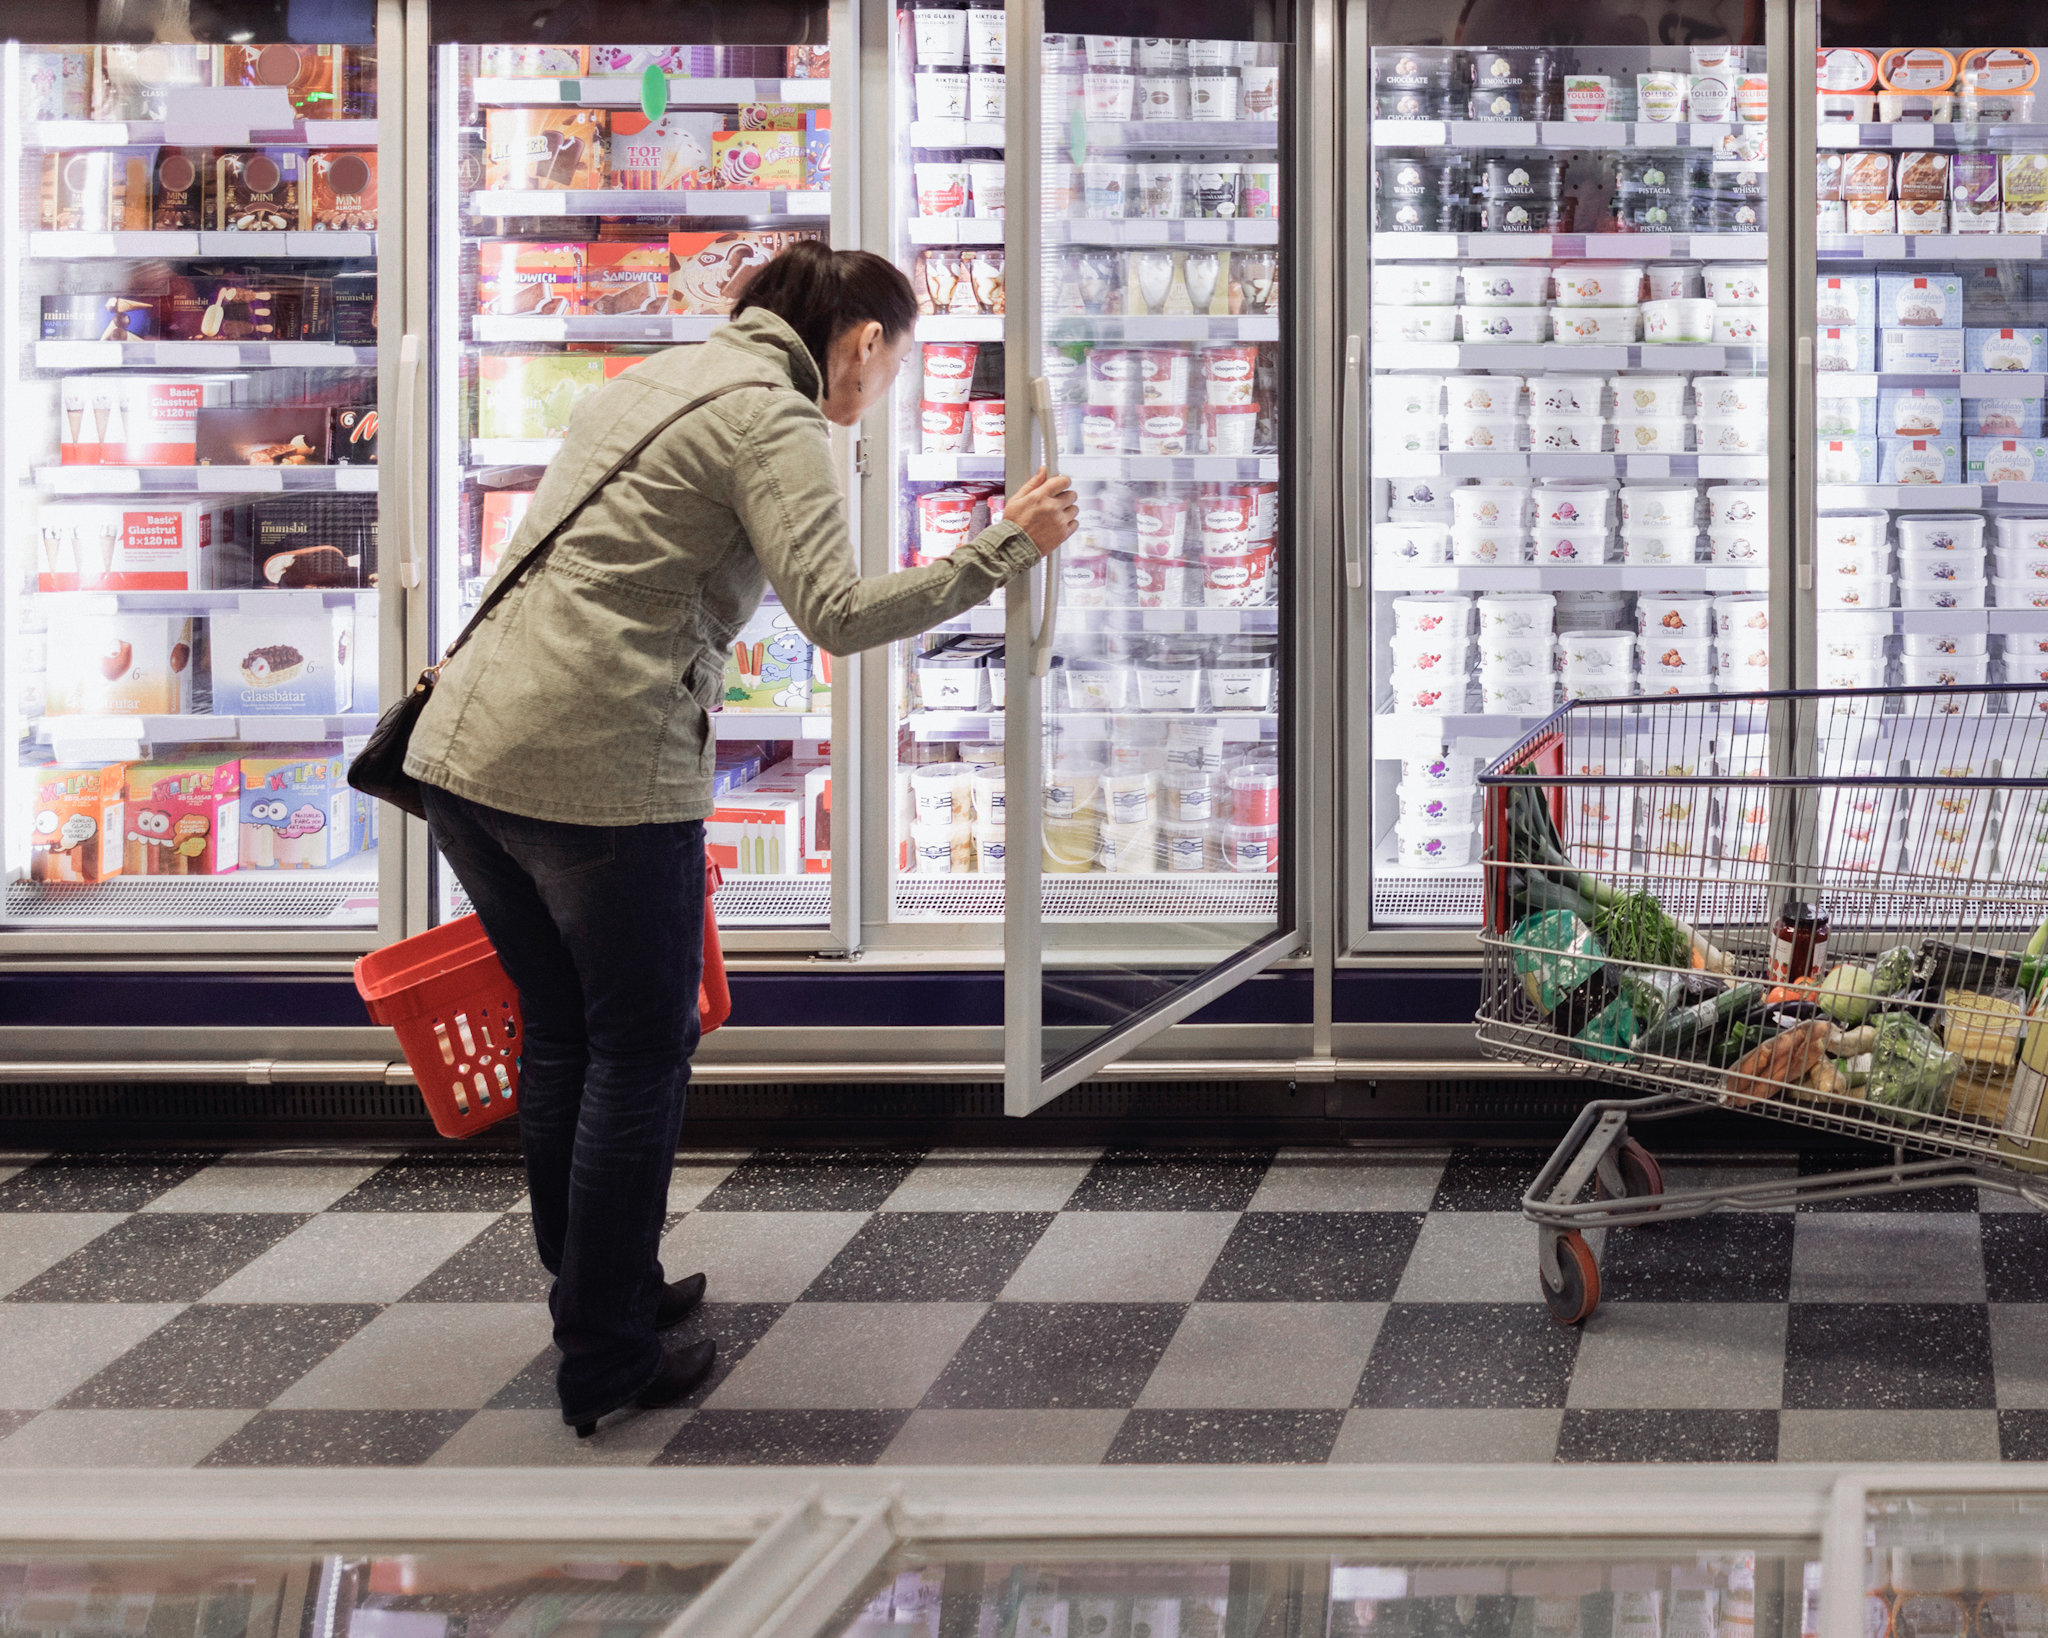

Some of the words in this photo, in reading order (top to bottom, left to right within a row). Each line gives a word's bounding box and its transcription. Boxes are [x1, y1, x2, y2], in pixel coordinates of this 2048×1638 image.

[1386, 76, 1429, 84] CHOCOLATE
[577, 112, 586, 125] 6
[627, 146, 662, 157] TOP
[763, 145, 807, 165] TWISTER
[628, 157, 660, 167] HAT
[1393, 186, 1426, 194] WALNUT
[1638, 187, 1671, 195] PISTACIA
[1732, 186, 1762, 194] WHISKY
[166, 192, 188, 200] MINI
[250, 193, 274, 201] MINI
[335, 195, 362, 205] MINI
[1392, 224, 1424, 232] WALNUT
[761, 236, 773, 244] 12
[562, 245, 570, 253] 6
[496, 271, 557, 283] SNDWICH
[601, 269, 662, 283] SANDWICH
[336, 292, 374, 302] mumsbit
[174, 297, 209, 308] mumsbit
[1986, 342, 2030, 355] Gräddglass
[587, 361, 598, 370] 15
[1213, 364, 1248, 373] Häagen-Dazs
[152, 398, 198, 407] Glasstrut
[1981, 401, 2024, 414] Gräddglass
[1898, 453, 1942, 467] Gräddglass
[1988, 453, 2032, 467] Gräddglass
[1970, 462, 1983, 470] NY!
[1207, 515, 1241, 524] Häagen-Dazs
[128, 526, 177, 535] Glasstrut
[261, 522, 308, 533] mumsbit
[163, 536, 178, 546] ml
[1214, 571, 1247, 581] Häagen-Dazs
[1661, 628, 1684, 636] Choklad
[306, 661, 315, 674] 6
[1661, 667, 1683, 675] Choklad
[240, 688, 306, 703] Glassbåtar
[269, 764, 327, 791] KALAS
[153, 773, 214, 802] KALAS
